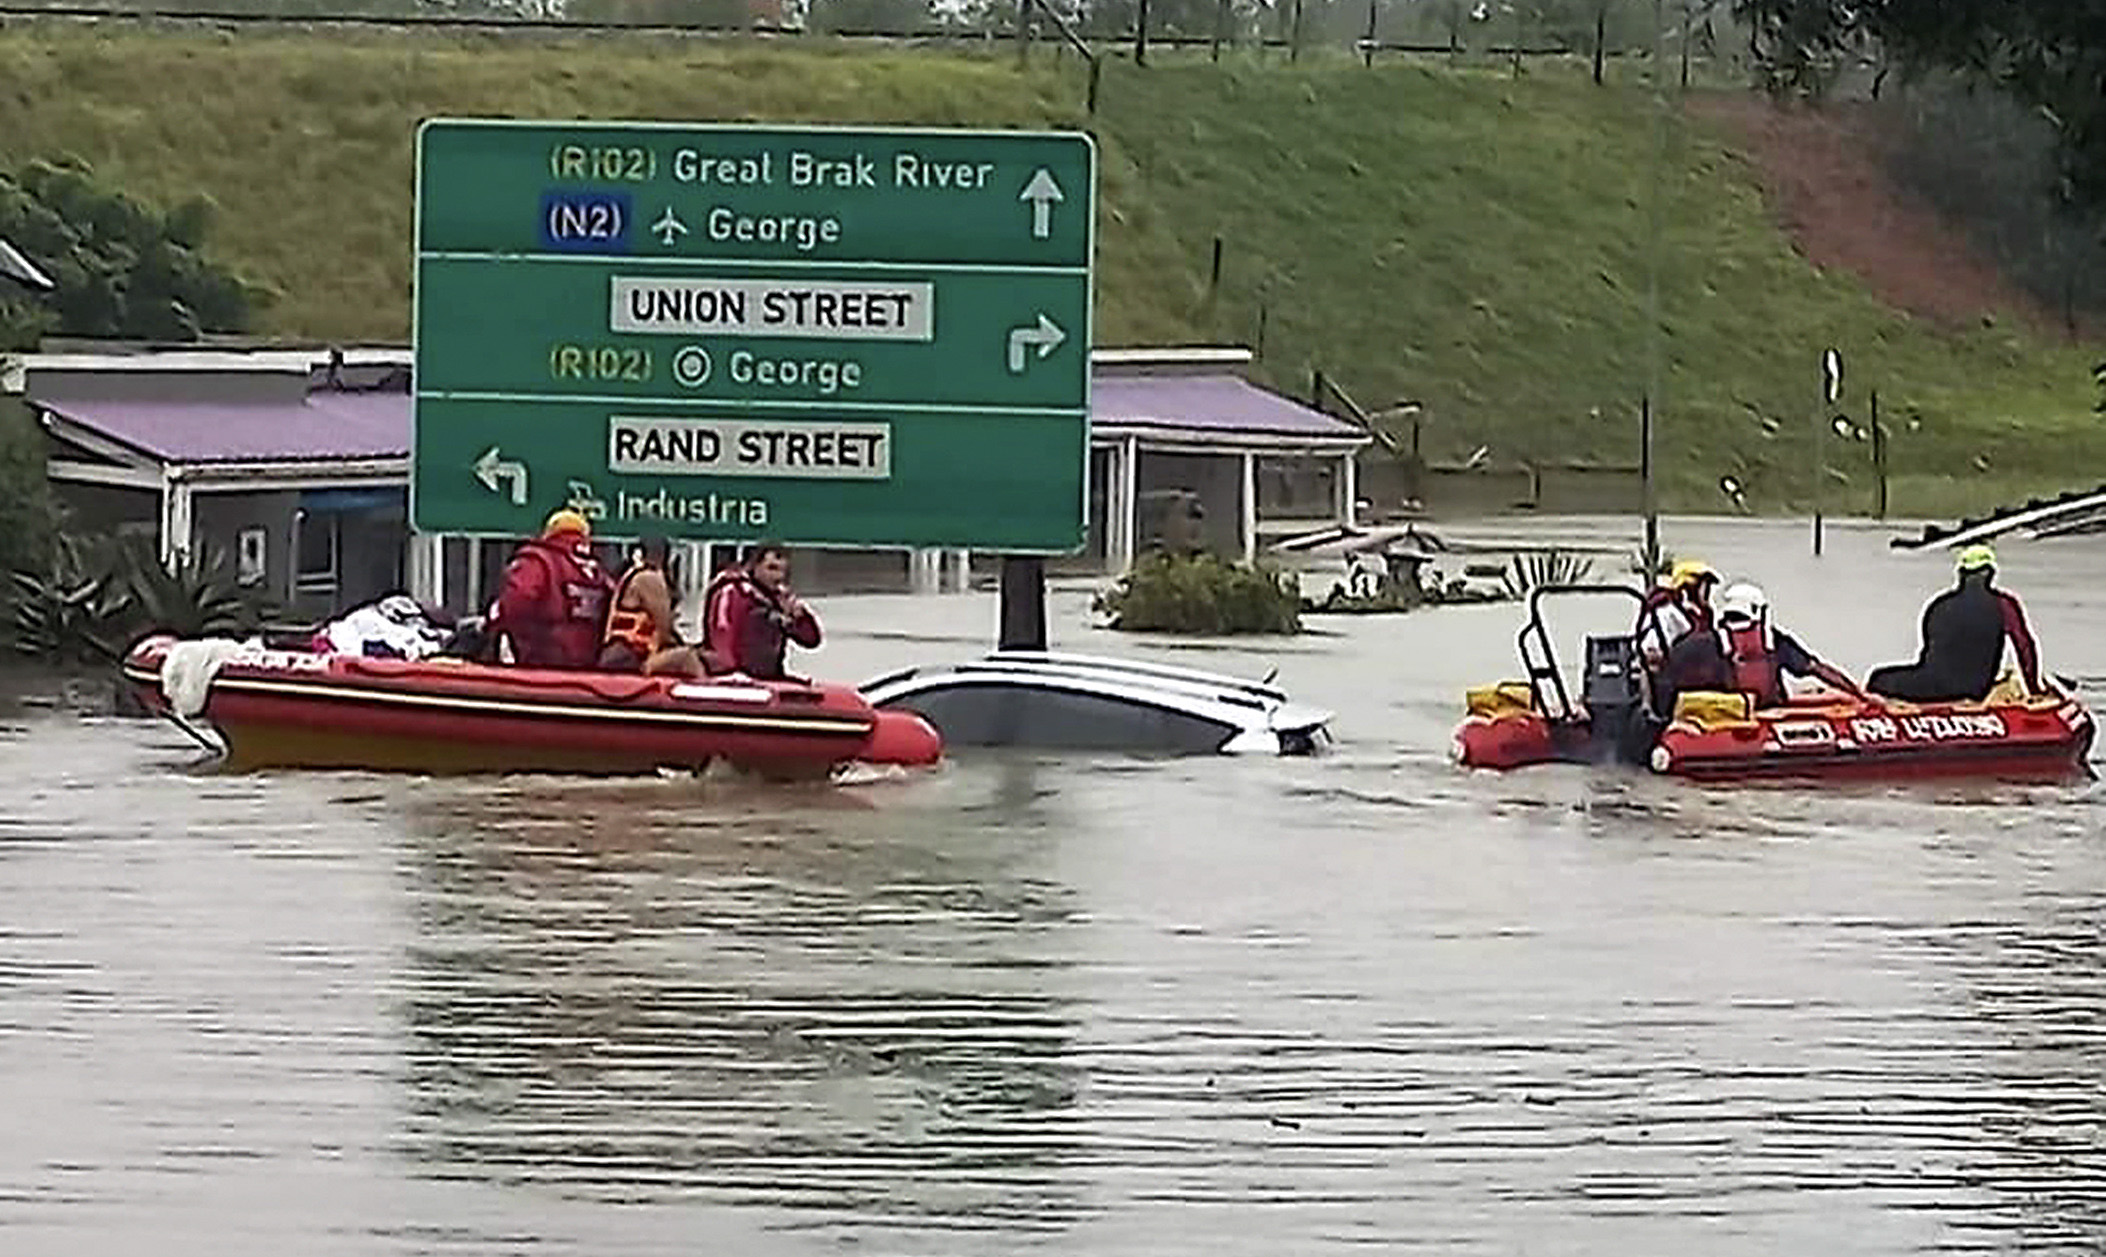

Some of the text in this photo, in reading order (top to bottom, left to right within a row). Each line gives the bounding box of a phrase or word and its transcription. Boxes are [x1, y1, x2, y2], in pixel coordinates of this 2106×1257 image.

[551, 146, 994, 187] (R102) Great Brak River
[551, 202, 840, 250] (N2) George
[631, 289, 912, 327] UNION STREET
[730, 352, 861, 393] George
[615, 428, 884, 467] RAND STREET
[618, 486, 767, 525] Industria
